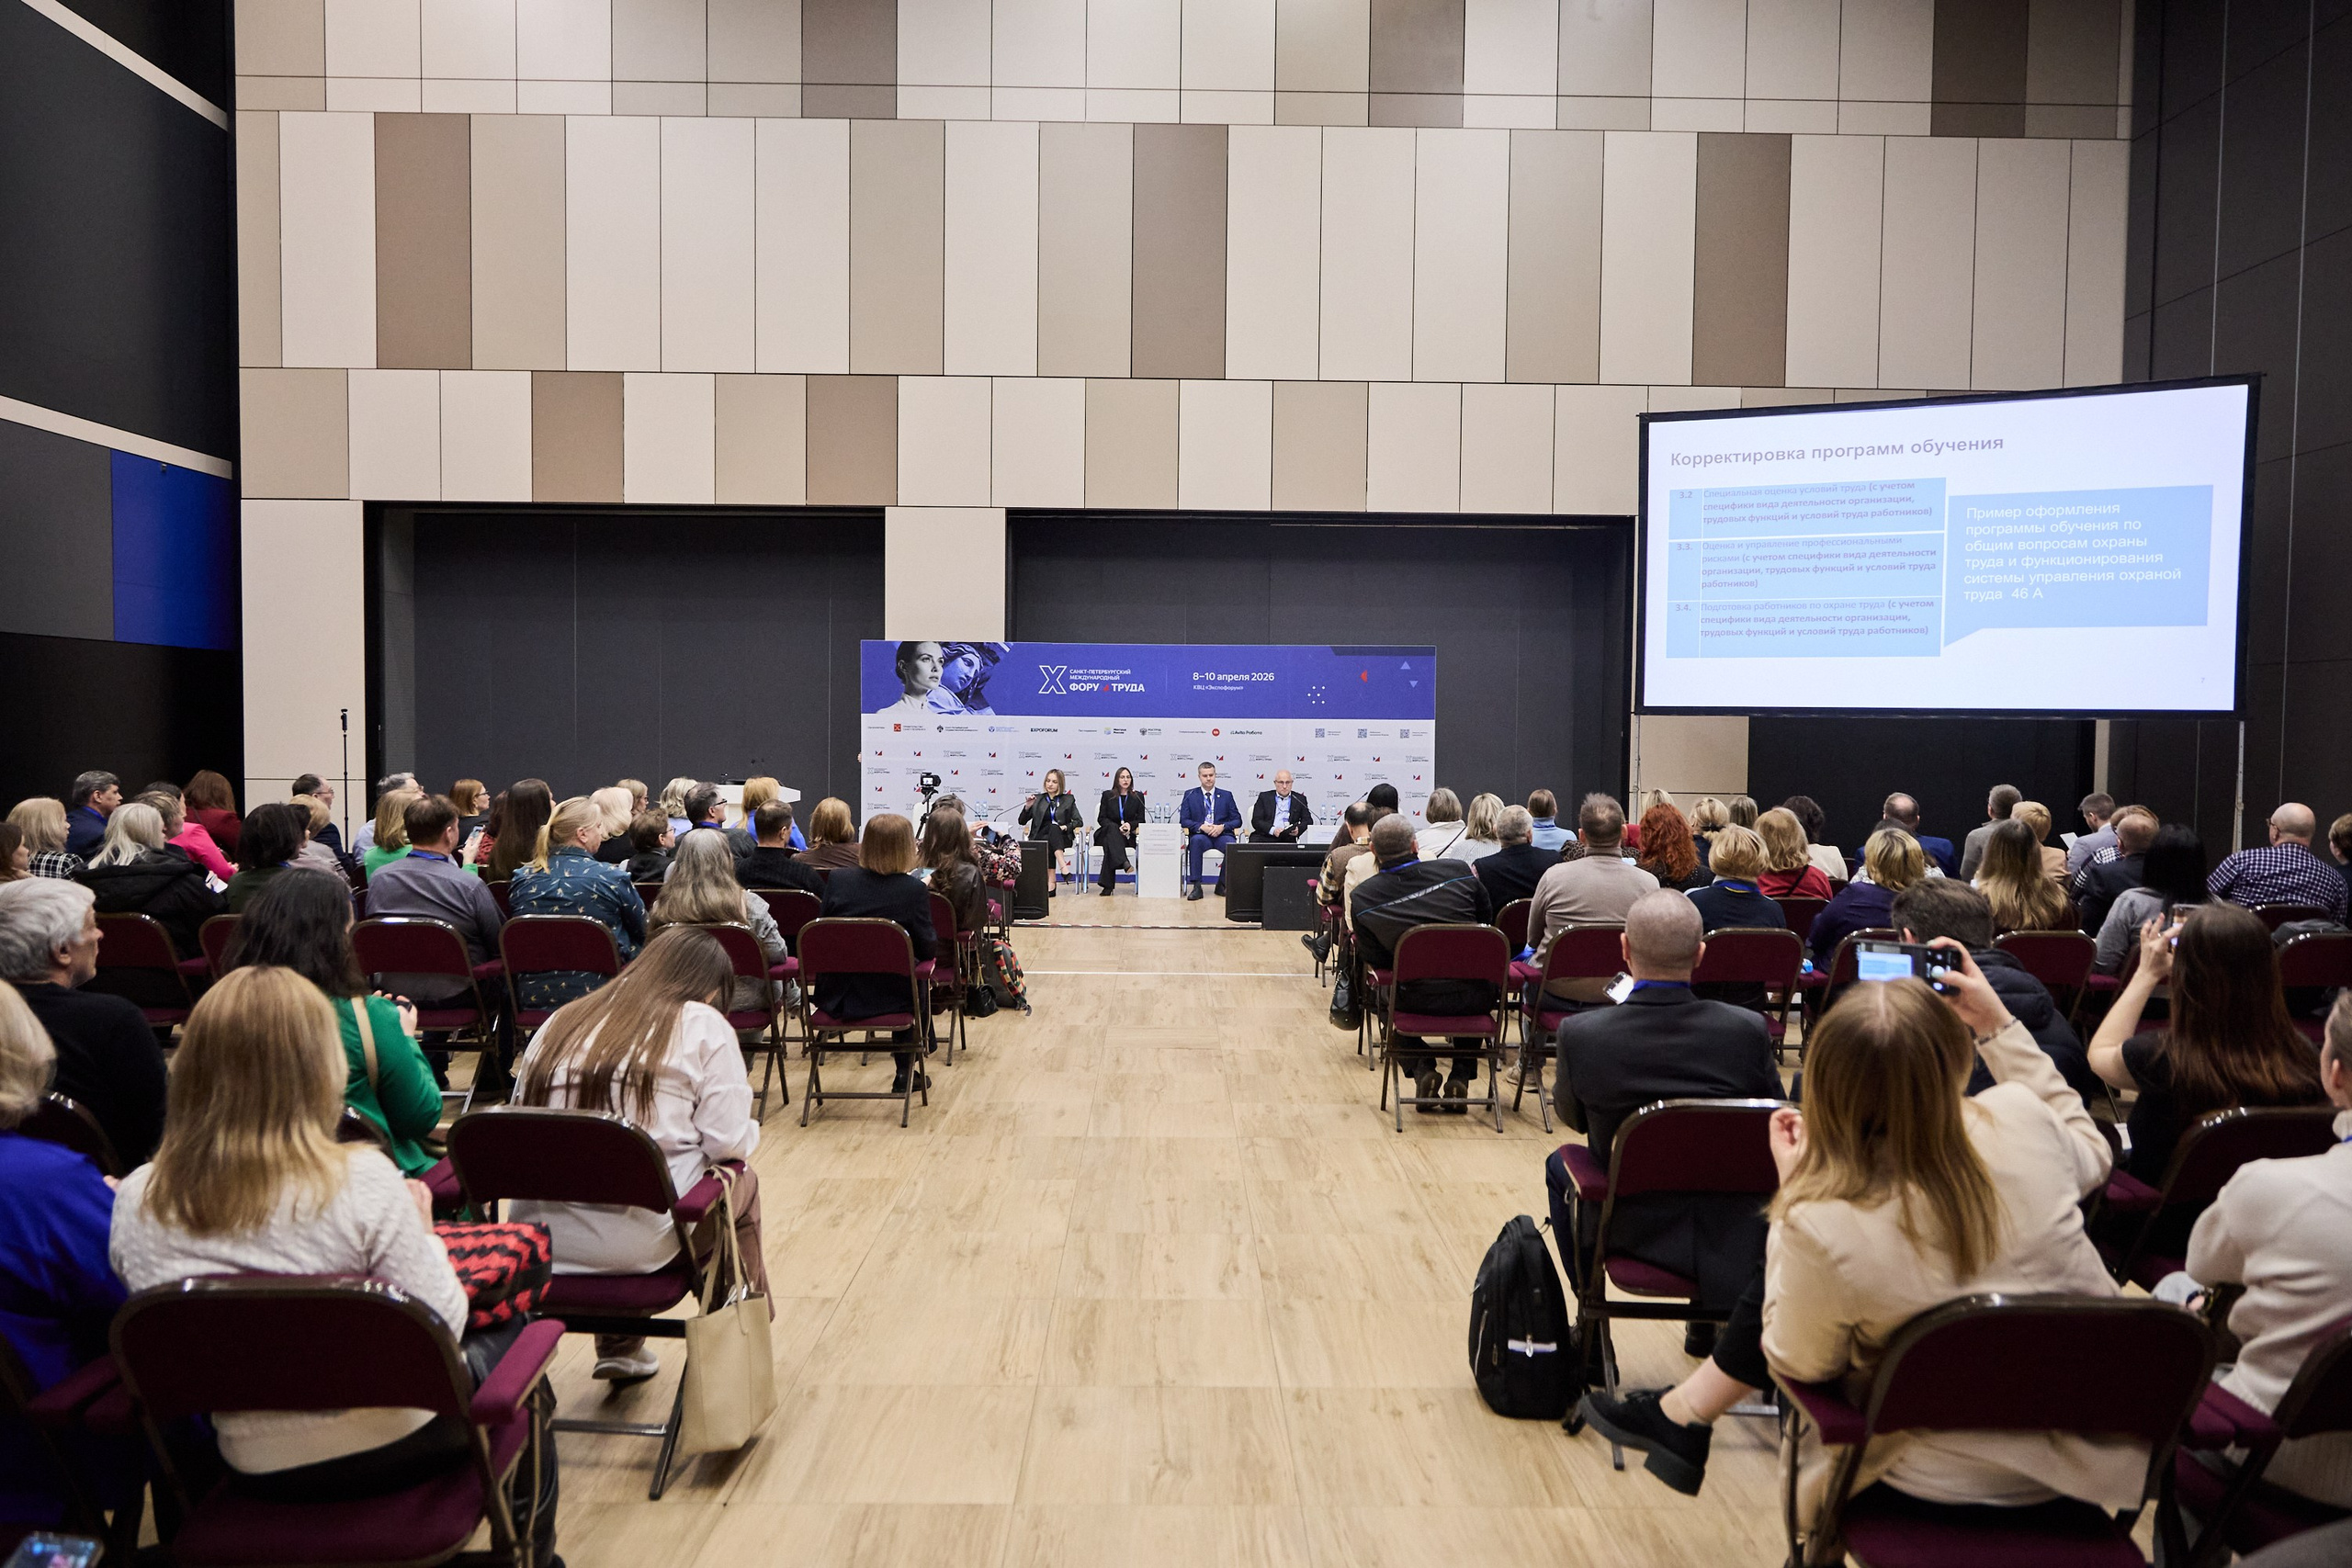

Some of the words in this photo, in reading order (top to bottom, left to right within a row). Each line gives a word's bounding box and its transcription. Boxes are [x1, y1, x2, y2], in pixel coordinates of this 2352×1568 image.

[1670, 449, 1806, 468] Корректировка
[1811, 444, 1905, 462] программ
[1910, 438, 2005, 457] обучения
[1679, 491, 1693, 500] 3.2
[1702, 490, 1763, 499] Специальная
[1764, 487, 1798, 497] оценка
[1800, 485, 1838, 495] условий
[1840, 483, 1867, 494] труда
[1869, 482, 1878, 492] (с
[1880, 482, 1916, 492] учетом
[1702, 502, 1755, 512] специфики
[1756, 502, 1780, 510] вида
[1781, 498, 1847, 509] деятельности
[1848, 495, 1916, 506] организации,
[1702, 514, 1747, 525] трудовых
[1747, 513, 1790, 524] функций
[1800, 510, 1839, 521] условий
[1841, 511, 1869, 521] труда
[1871, 507, 1933, 519] работников)
[1966, 507, 2022, 522] Пример
[2025, 503, 2120, 520] оформления
[1965, 524, 2046, 537] программы
[2050, 520, 2119, 536] обучения
[2123, 520, 2143, 531] по
[1676, 543, 1693, 551] 3.3.
[1702, 542, 1736, 551] Оценка
[1736, 542, 1744, 550] и
[1745, 539, 1800, 550] управление
[1801, 537, 1903, 548] профессиональными
[1964, 539, 2014, 553] общим
[2018, 538, 2088, 552] вопросам
[2092, 537, 2148, 550] охраны
[1702, 555, 1740, 564] рисками
[1742, 553, 1750, 563] (с
[1752, 553, 1786, 563] учетом
[1787, 552, 1841, 562] специфики
[1843, 551, 1867, 560] вида
[1868, 549, 1938, 560] деятельности
[1964, 557, 2004, 570] труда
[2008, 558, 2018, 567] и
[2020, 553, 2164, 569] функционирования
[1702, 567, 1764, 577] организации,
[1765, 565, 1811, 576] трудовых
[1812, 563, 1855, 574] функций
[1865, 561, 1906, 572] условий
[1908, 562, 1937, 572] труда
[1963, 573, 2025, 584] системы
[2029, 571, 2115, 585] управления
[2119, 568, 2182, 583] охраной
[1701, 579, 1758, 590] работников)
[1963, 590, 2003, 603] труда
[2011, 587, 2029, 600] 46
[2032, 587, 2043, 599] А
[1675, 604, 1691, 612] 3.4.
[1700, 603, 1752, 613] Подготовка
[1754, 601, 1807, 612] работников
[1809, 602, 1821, 610] по
[1823, 602, 1857, 611] охране
[1859, 601, 1885, 610] труда
[1887, 599, 1896, 610] (с
[1898, 600, 1935, 610] учетом
[1700, 615, 1752, 625] специфики
[1753, 616, 1776, 625] вида
[1778, 615, 1843, 625] деятельности
[1844, 614, 1911, 624] организации,
[1700, 628, 1744, 637] трудовых
[1745, 626, 1788, 637] функций
[1796, 626, 1837, 637] условий
[1838, 627, 1865, 637] труда
[1867, 626, 1929, 636] работников)
[1216, 673, 1250, 682] апреля
[1250, 672, 1275, 682] 2026
[1111, 682, 1146, 693] ТРУДА
